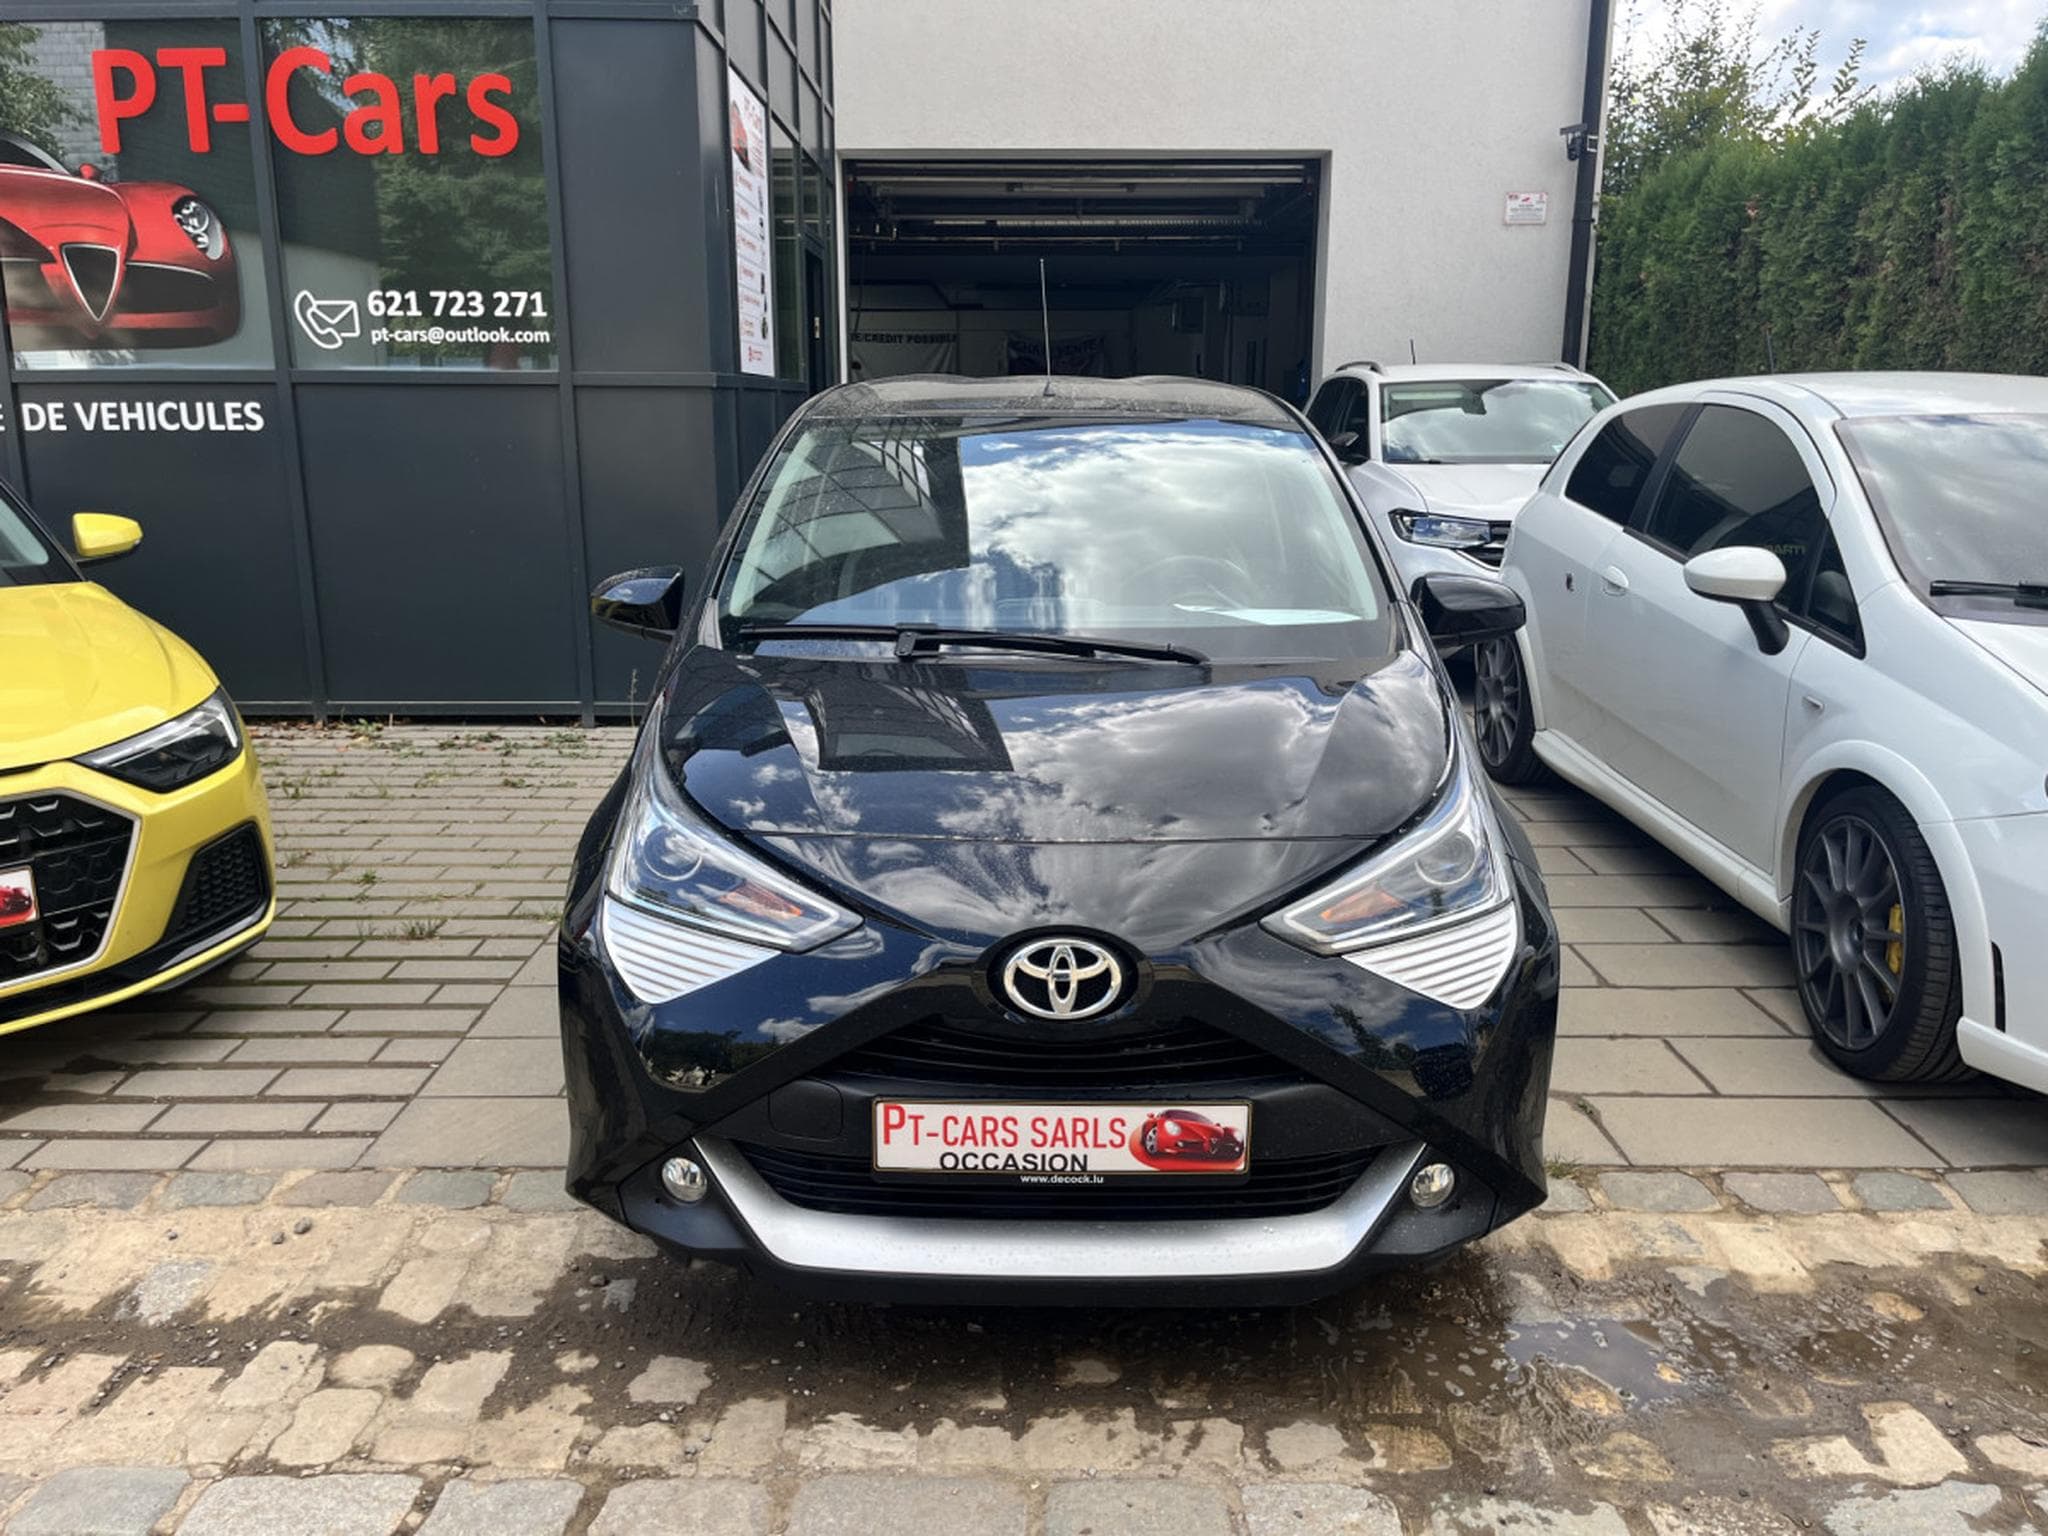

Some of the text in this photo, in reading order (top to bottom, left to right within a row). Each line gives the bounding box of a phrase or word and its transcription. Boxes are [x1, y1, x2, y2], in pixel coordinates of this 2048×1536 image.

[92, 47, 520, 157] PT-Cars
[367, 290, 547, 317] 621 723 271
[371, 327, 550, 345] pt-cars@outlook.com
[21, 402, 67, 431] DE
[73, 402, 265, 431] VEHICULES
[883, 1103, 1127, 1148] PT-CARS SARLS
[939, 1152, 1088, 1171] OCCASION
[1020, 1174, 1104, 1184] www.decock.lu
